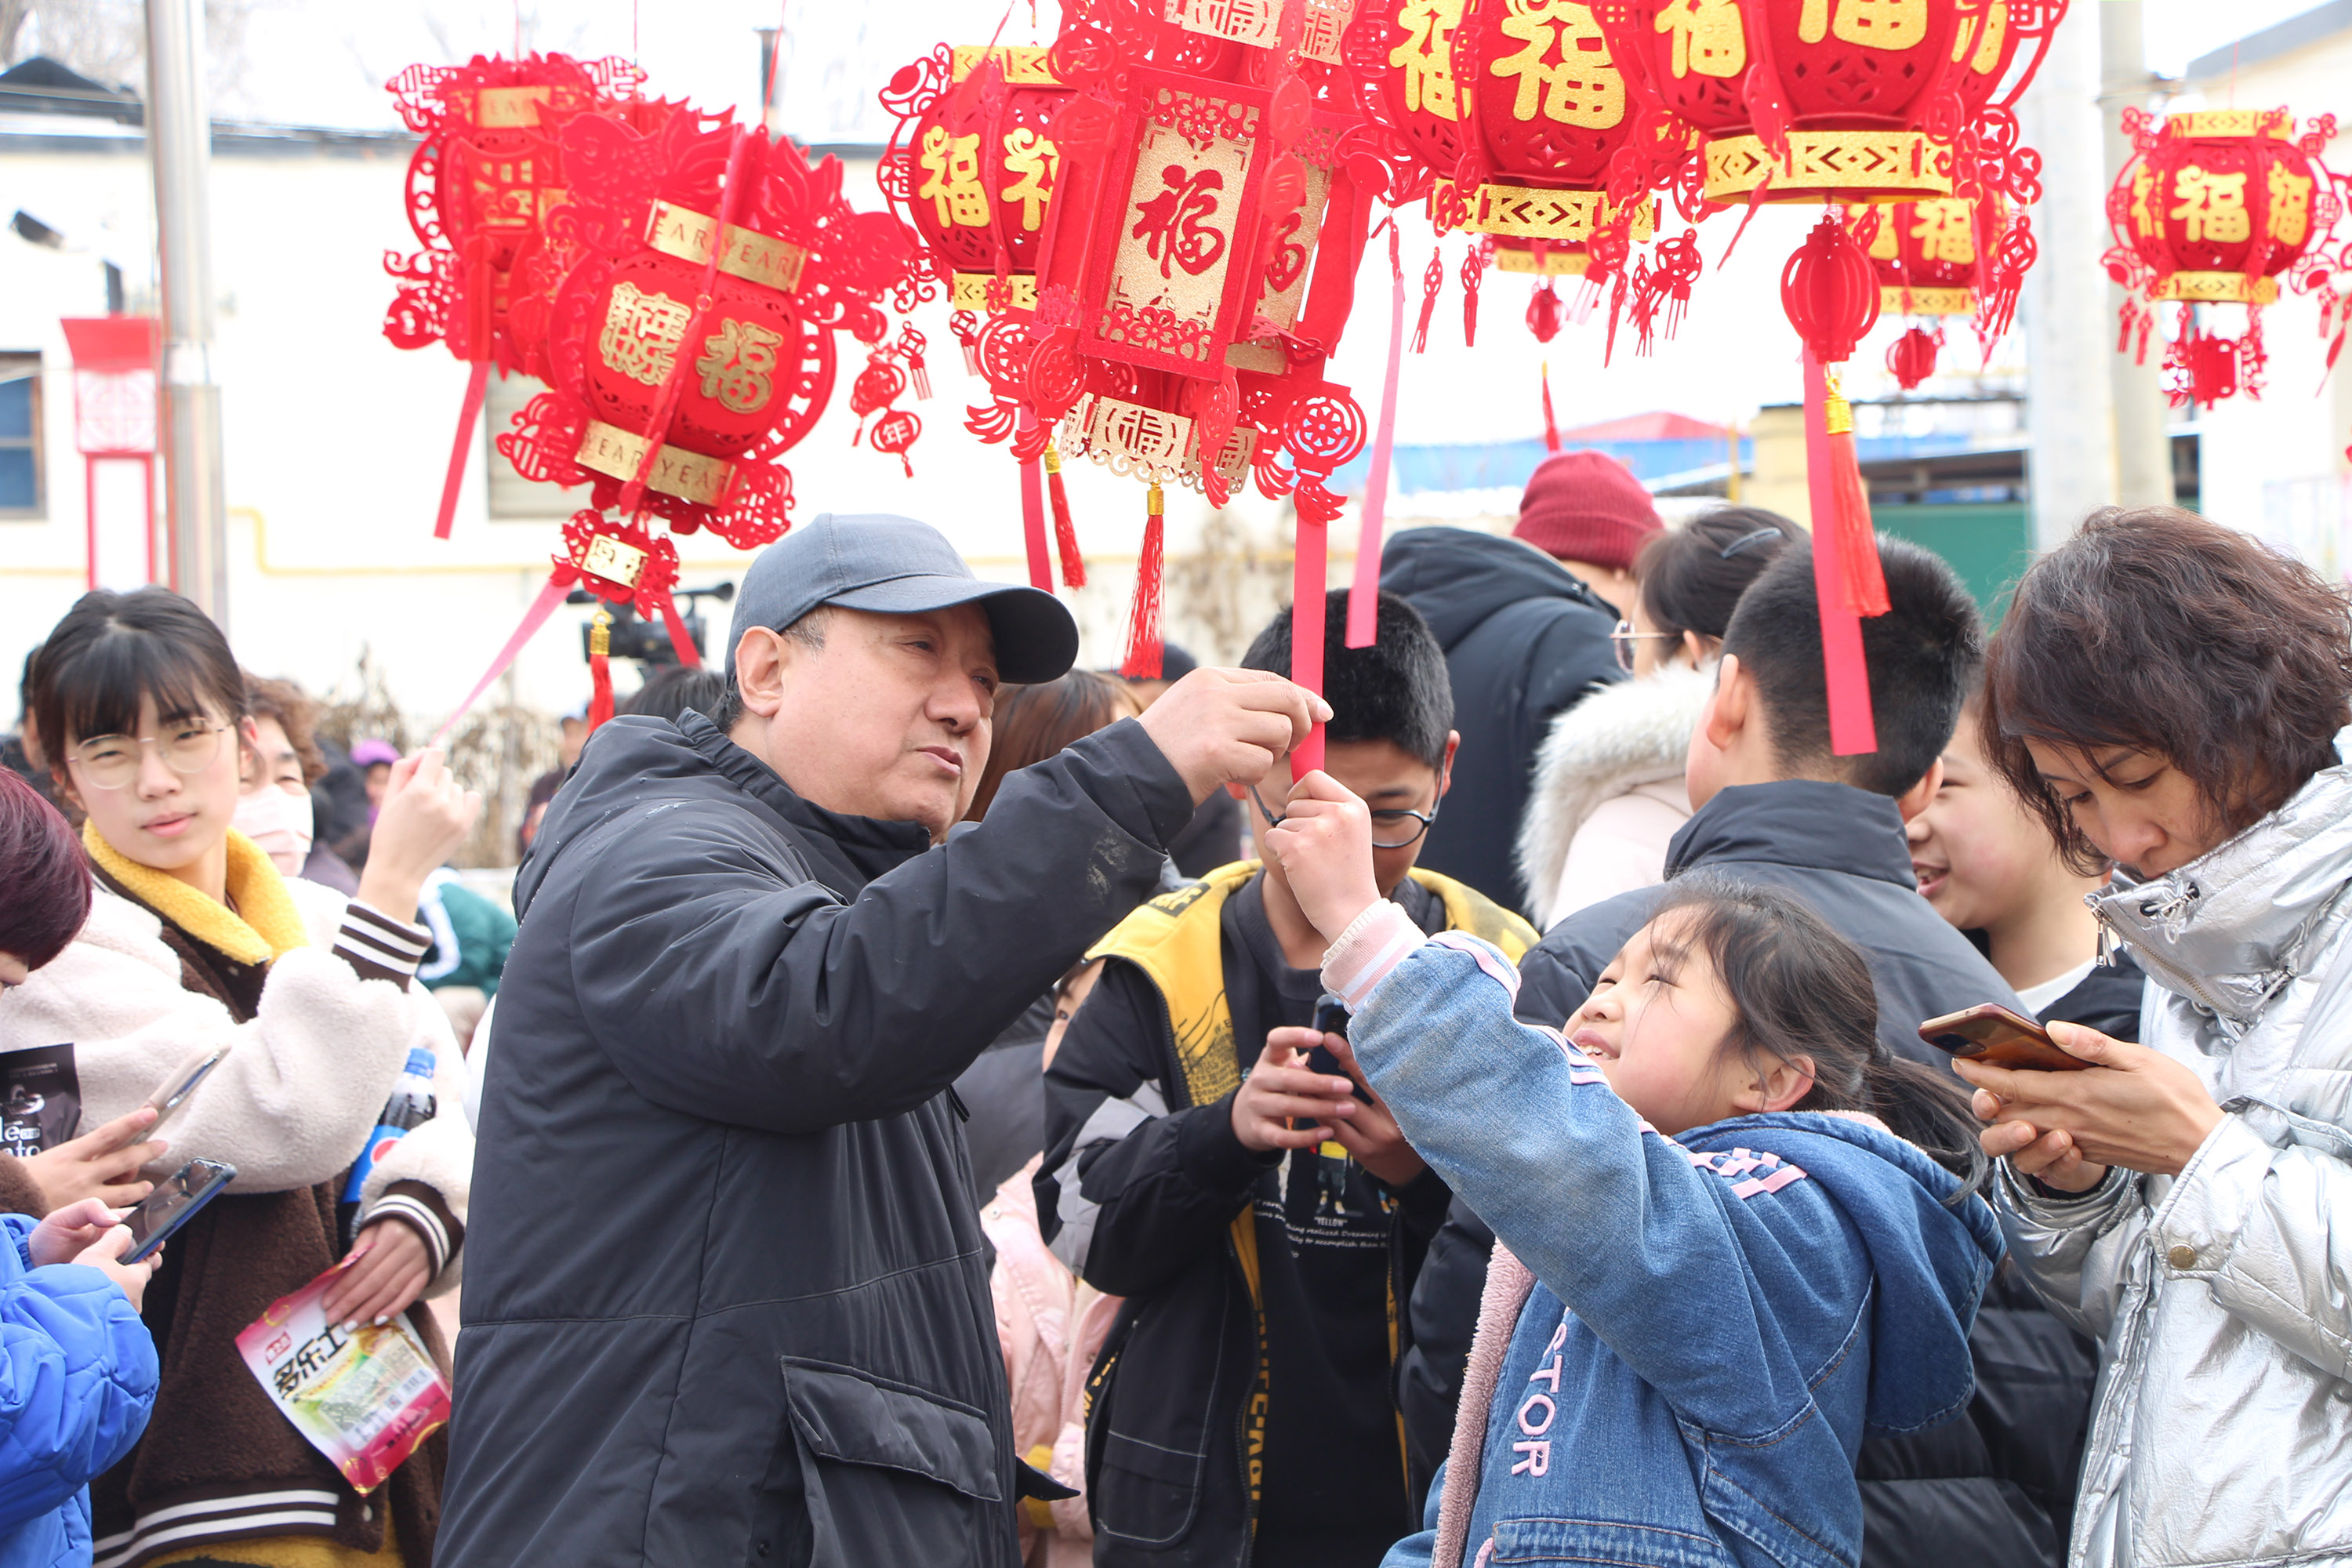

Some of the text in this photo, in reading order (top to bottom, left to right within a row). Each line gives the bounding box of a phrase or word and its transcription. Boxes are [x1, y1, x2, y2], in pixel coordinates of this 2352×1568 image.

[1490, 0, 1626, 130] 福
[919, 125, 991, 228] 福
[2171, 165, 2251, 243] 福
[1133, 164, 1225, 279] 福
[1910, 196, 1976, 265] 福
[696, 317, 782, 414] 福
[882, 419, 910, 445] 年
[1117, 409, 1163, 456] 福
